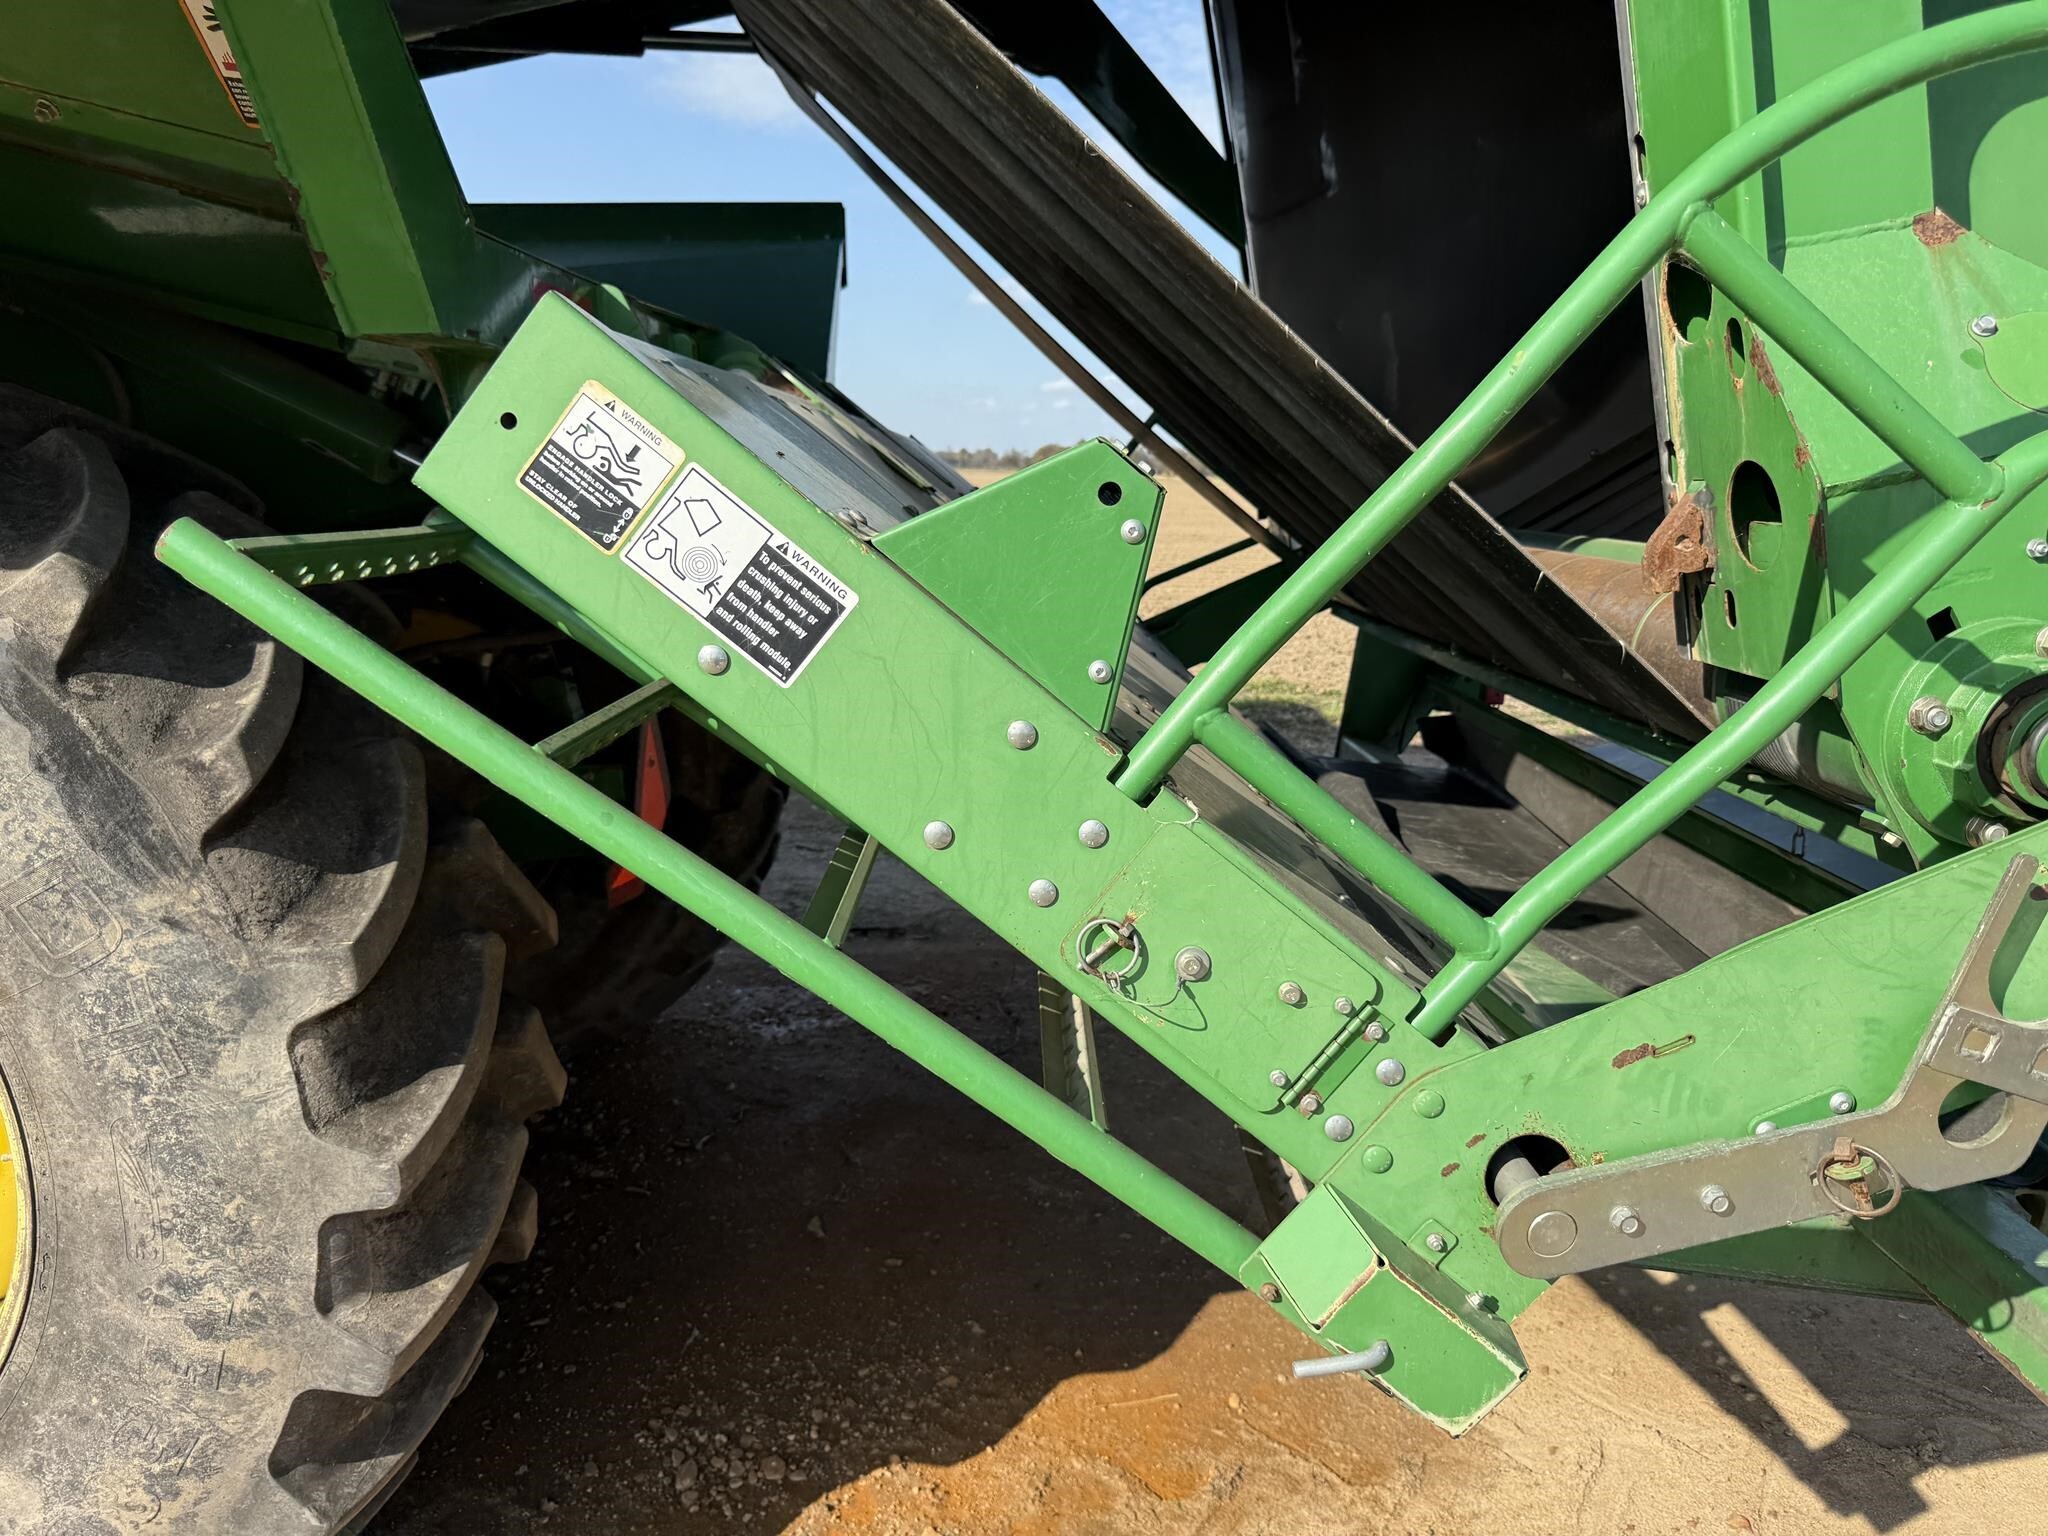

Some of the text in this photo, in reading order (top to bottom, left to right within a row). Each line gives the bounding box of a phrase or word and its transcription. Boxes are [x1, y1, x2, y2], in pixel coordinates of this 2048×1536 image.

[621, 409, 662, 446] WARNING
[524, 475, 580, 520] UNLOCKED HANDLER
[528, 469, 577, 508] STAY CLEAR OF
[542, 450, 560, 466] before
[557, 462, 581, 482] working
[580, 480, 588, 488] on
[593, 491, 613, 507] around
[547, 444, 623, 505] ENGAGE HANDLER LOCK
[558, 470, 564, 478] in
[747, 566, 818, 624] crushing injury or
[758, 550, 831, 614] To prevent serious
[791, 549, 847, 599] WARNING
[726, 591, 779, 637] from handler
[736, 579, 807, 639] death, keep away
[715, 606, 791, 671] and rolling module.
